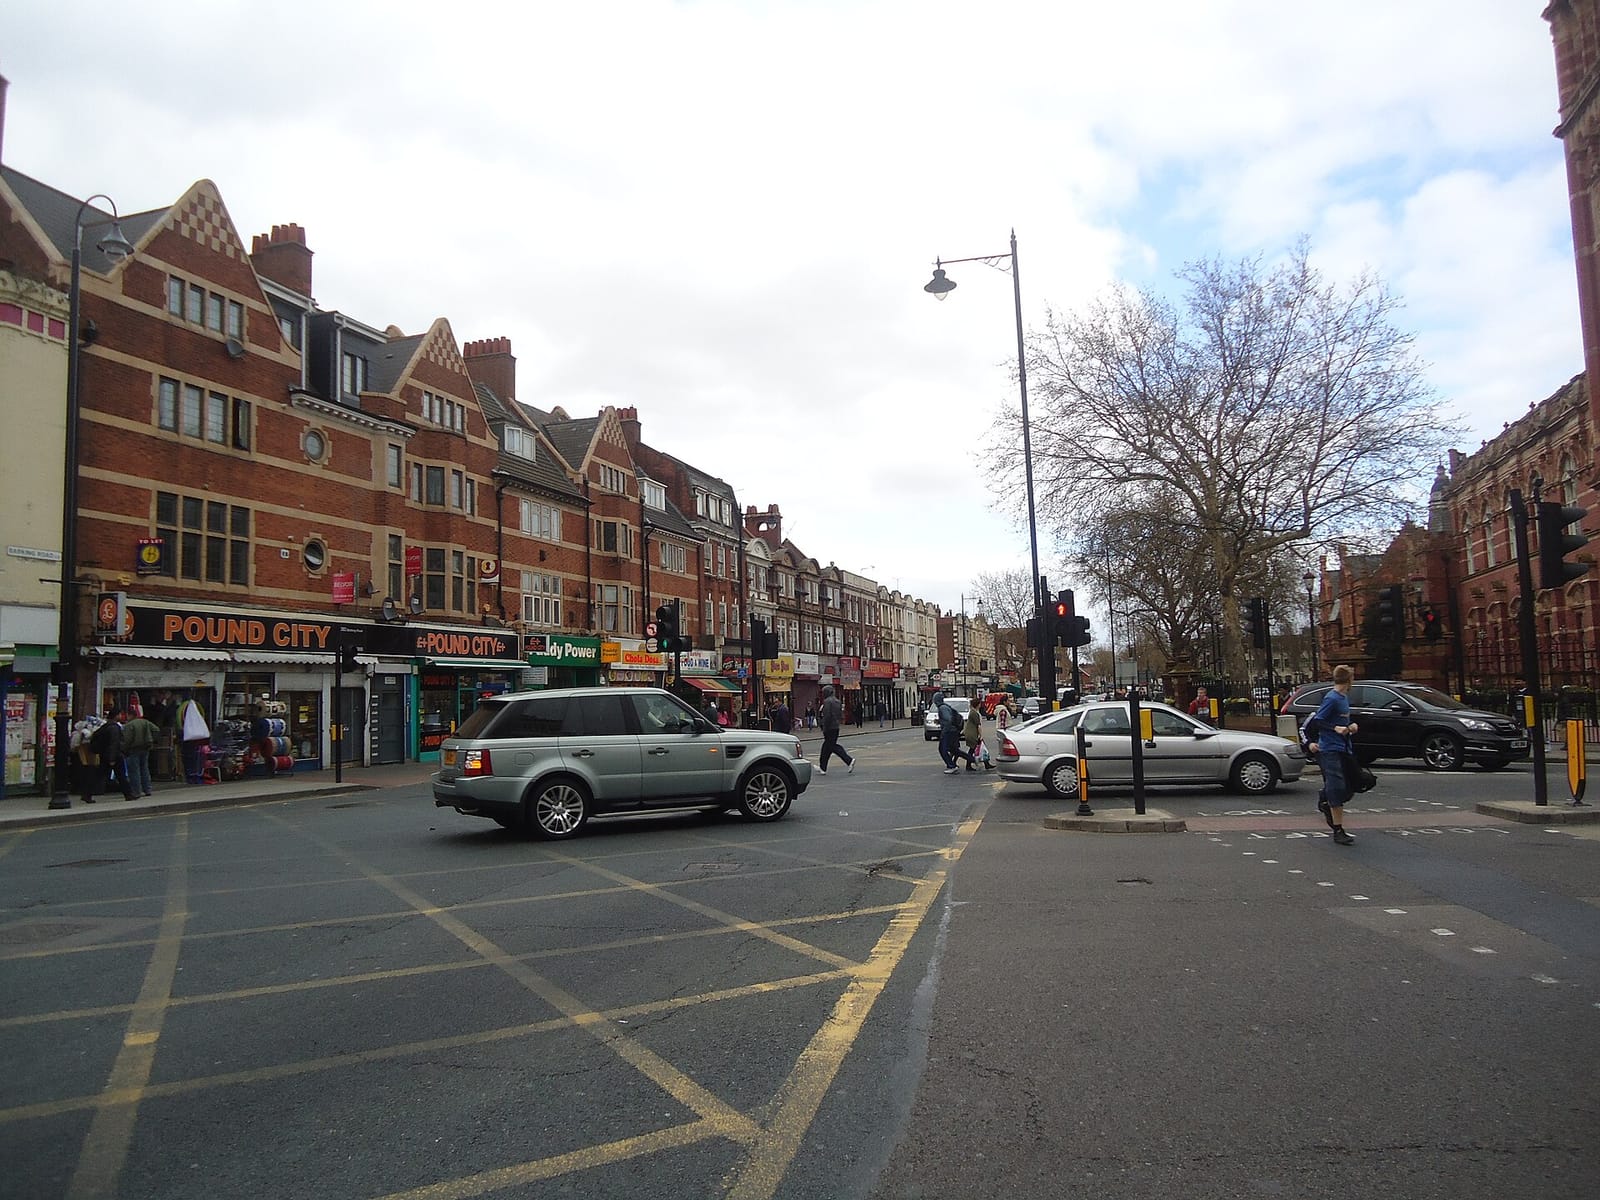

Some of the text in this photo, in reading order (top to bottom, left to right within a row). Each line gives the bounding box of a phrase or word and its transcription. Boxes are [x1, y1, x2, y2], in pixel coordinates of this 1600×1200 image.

[164, 614, 332, 649] POUND CITY
[427, 632, 470, 656] POUND
[472, 635, 498, 656] CITY
[564, 642, 597, 659] Power
[624, 653, 659, 665] Chola Dosa
[1197, 808, 1292, 817] LOOK
